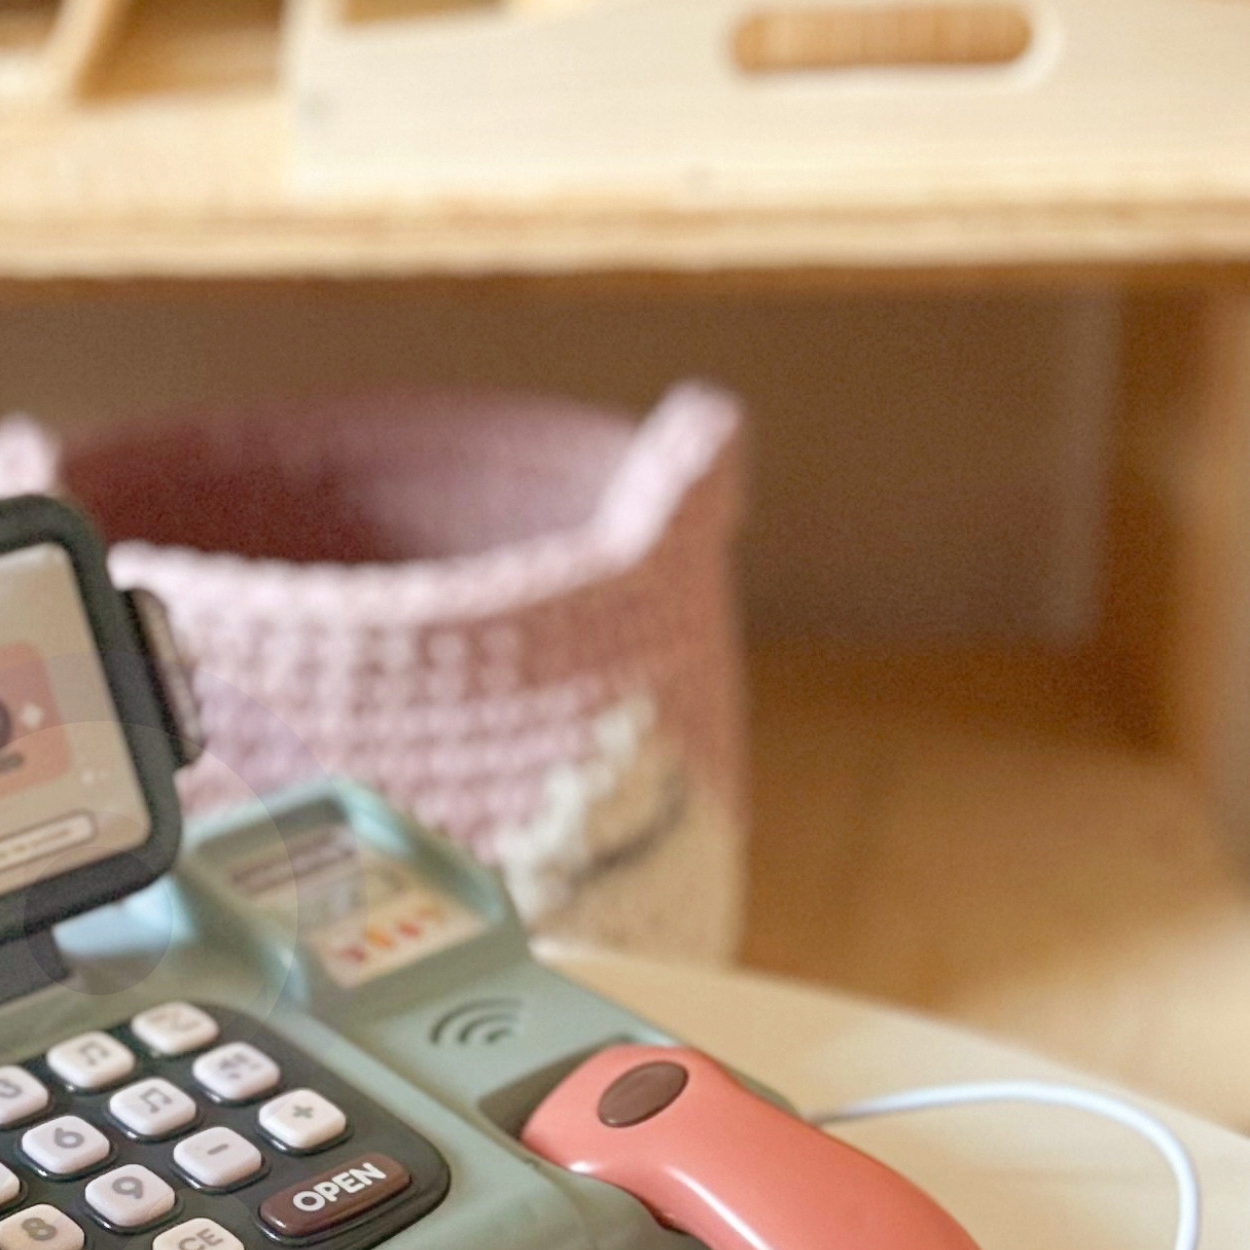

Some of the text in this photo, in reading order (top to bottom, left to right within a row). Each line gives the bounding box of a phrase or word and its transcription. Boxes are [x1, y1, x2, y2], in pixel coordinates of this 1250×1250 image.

[53, 1127, 85, 1149] 6
[111, 1175, 144, 1200] 9
[293, 1162, 386, 1212] OPEN
[21, 1217, 56, 1241] 8
